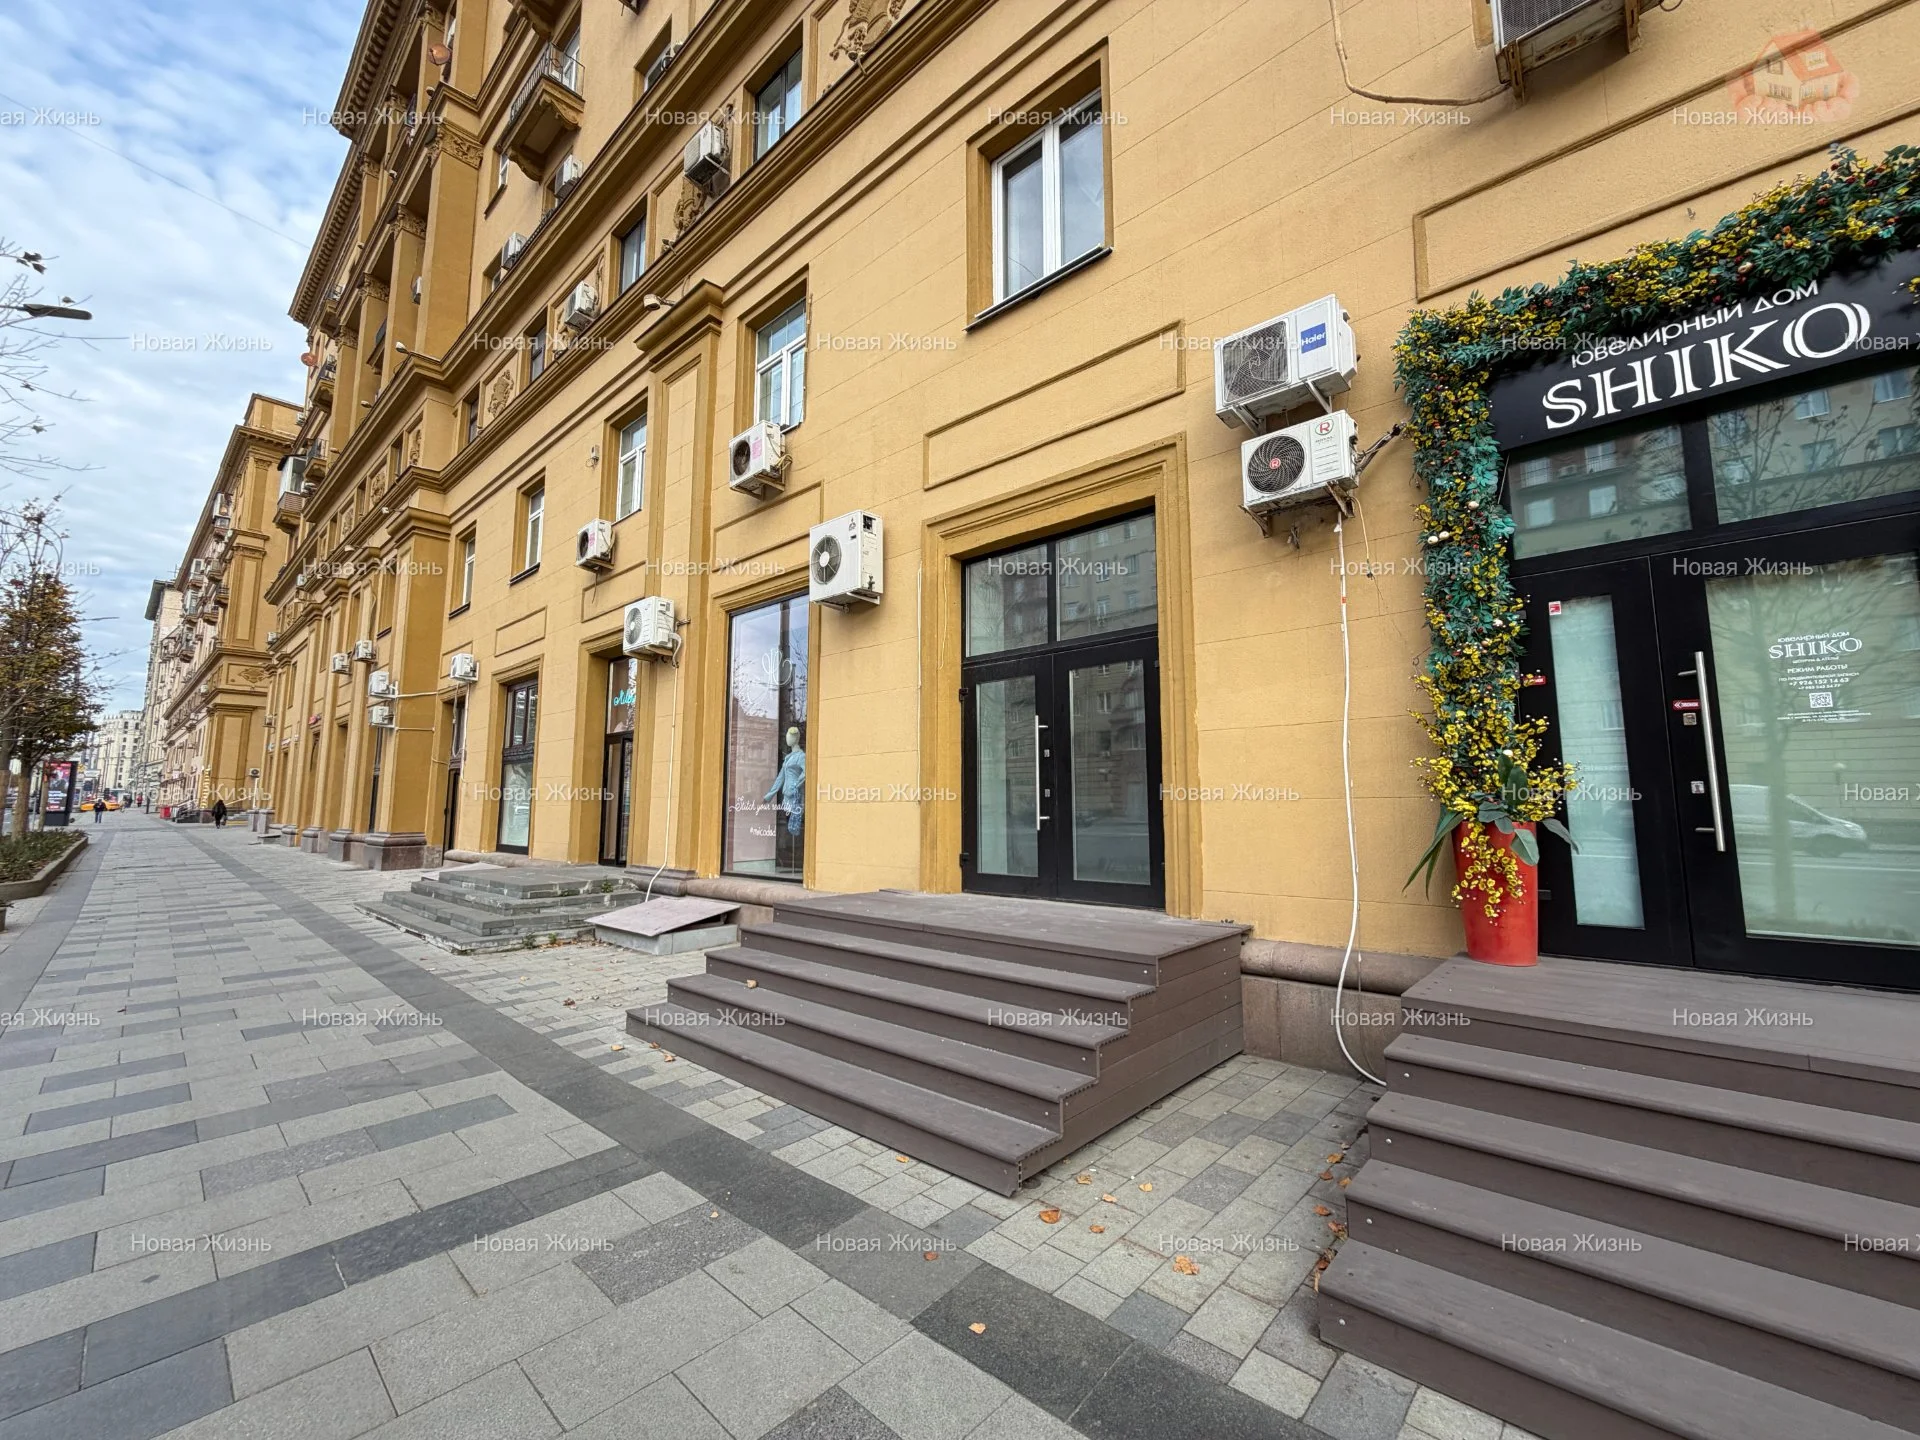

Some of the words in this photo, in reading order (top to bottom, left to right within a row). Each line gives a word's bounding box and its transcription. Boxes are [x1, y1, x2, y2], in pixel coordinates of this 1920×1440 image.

[1301, 331, 1326, 347] Haier
[1542, 302, 1871, 430] SHIKO
[1768, 637, 1862, 659] SHIKO
[1787, 666, 1815, 674] РЕЖИМ
[1816, 664, 1848, 672] РАБОТЫ
[756, 802, 771, 816] your
